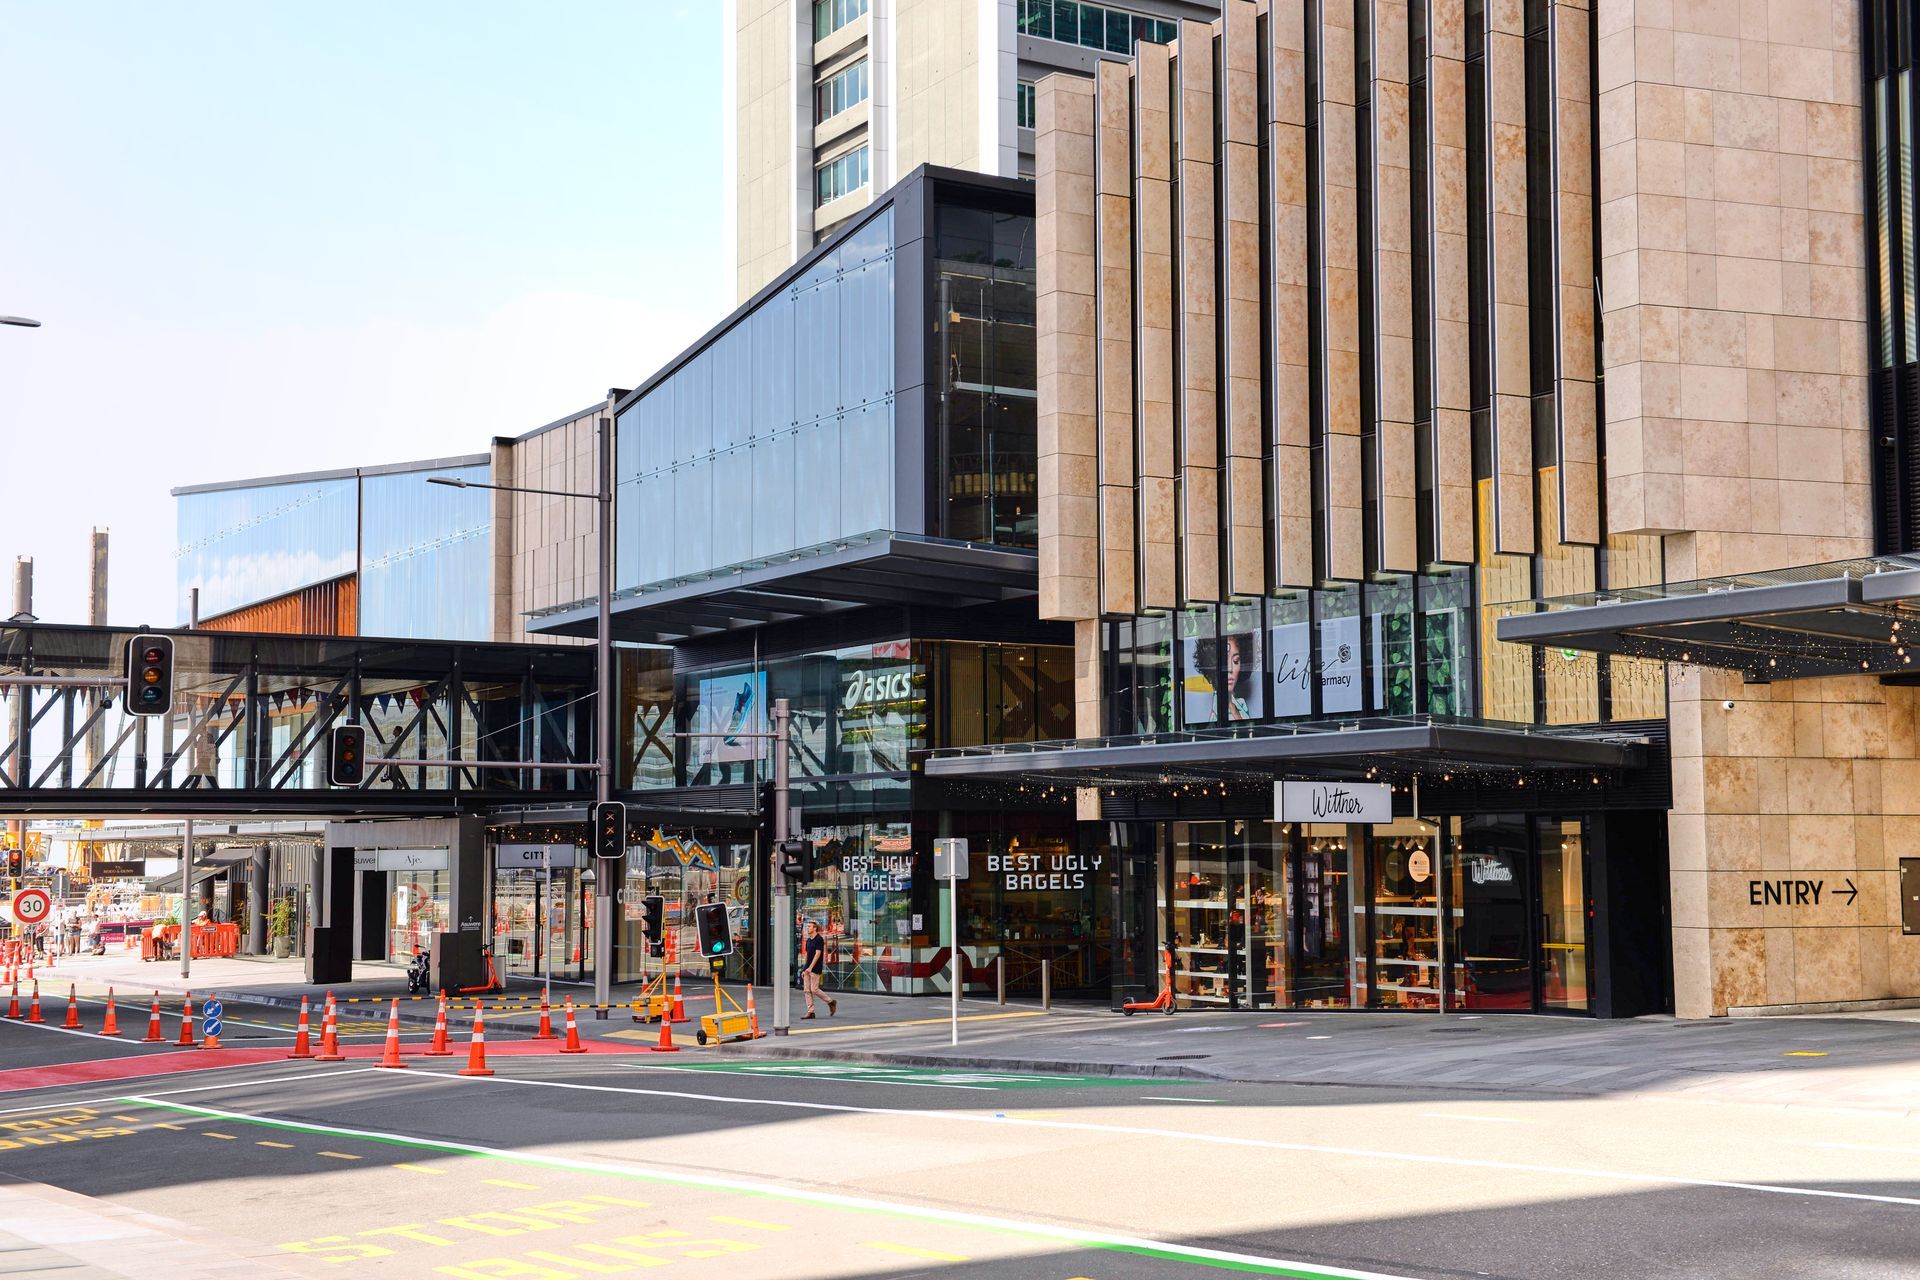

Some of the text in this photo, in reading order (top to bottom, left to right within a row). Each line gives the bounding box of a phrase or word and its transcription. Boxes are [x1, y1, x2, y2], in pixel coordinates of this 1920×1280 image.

[1321, 674, 1351, 688] armacy
[1312, 786, 1363, 817] Wittner
[354, 857, 376, 865] suwer
[522, 851, 552, 860] CITT
[842, 855, 913, 872] BEST UGLY
[987, 855, 1102, 872] BEST UGLY
[853, 874, 903, 891] BAGELS
[1006, 873, 1085, 890] BAGELS
[1749, 880, 1824, 905] ENTRY
[23, 900, 42, 913] 30
[276, 1198, 604, 1263] STOP
[430, 1229, 767, 1280] BUS
